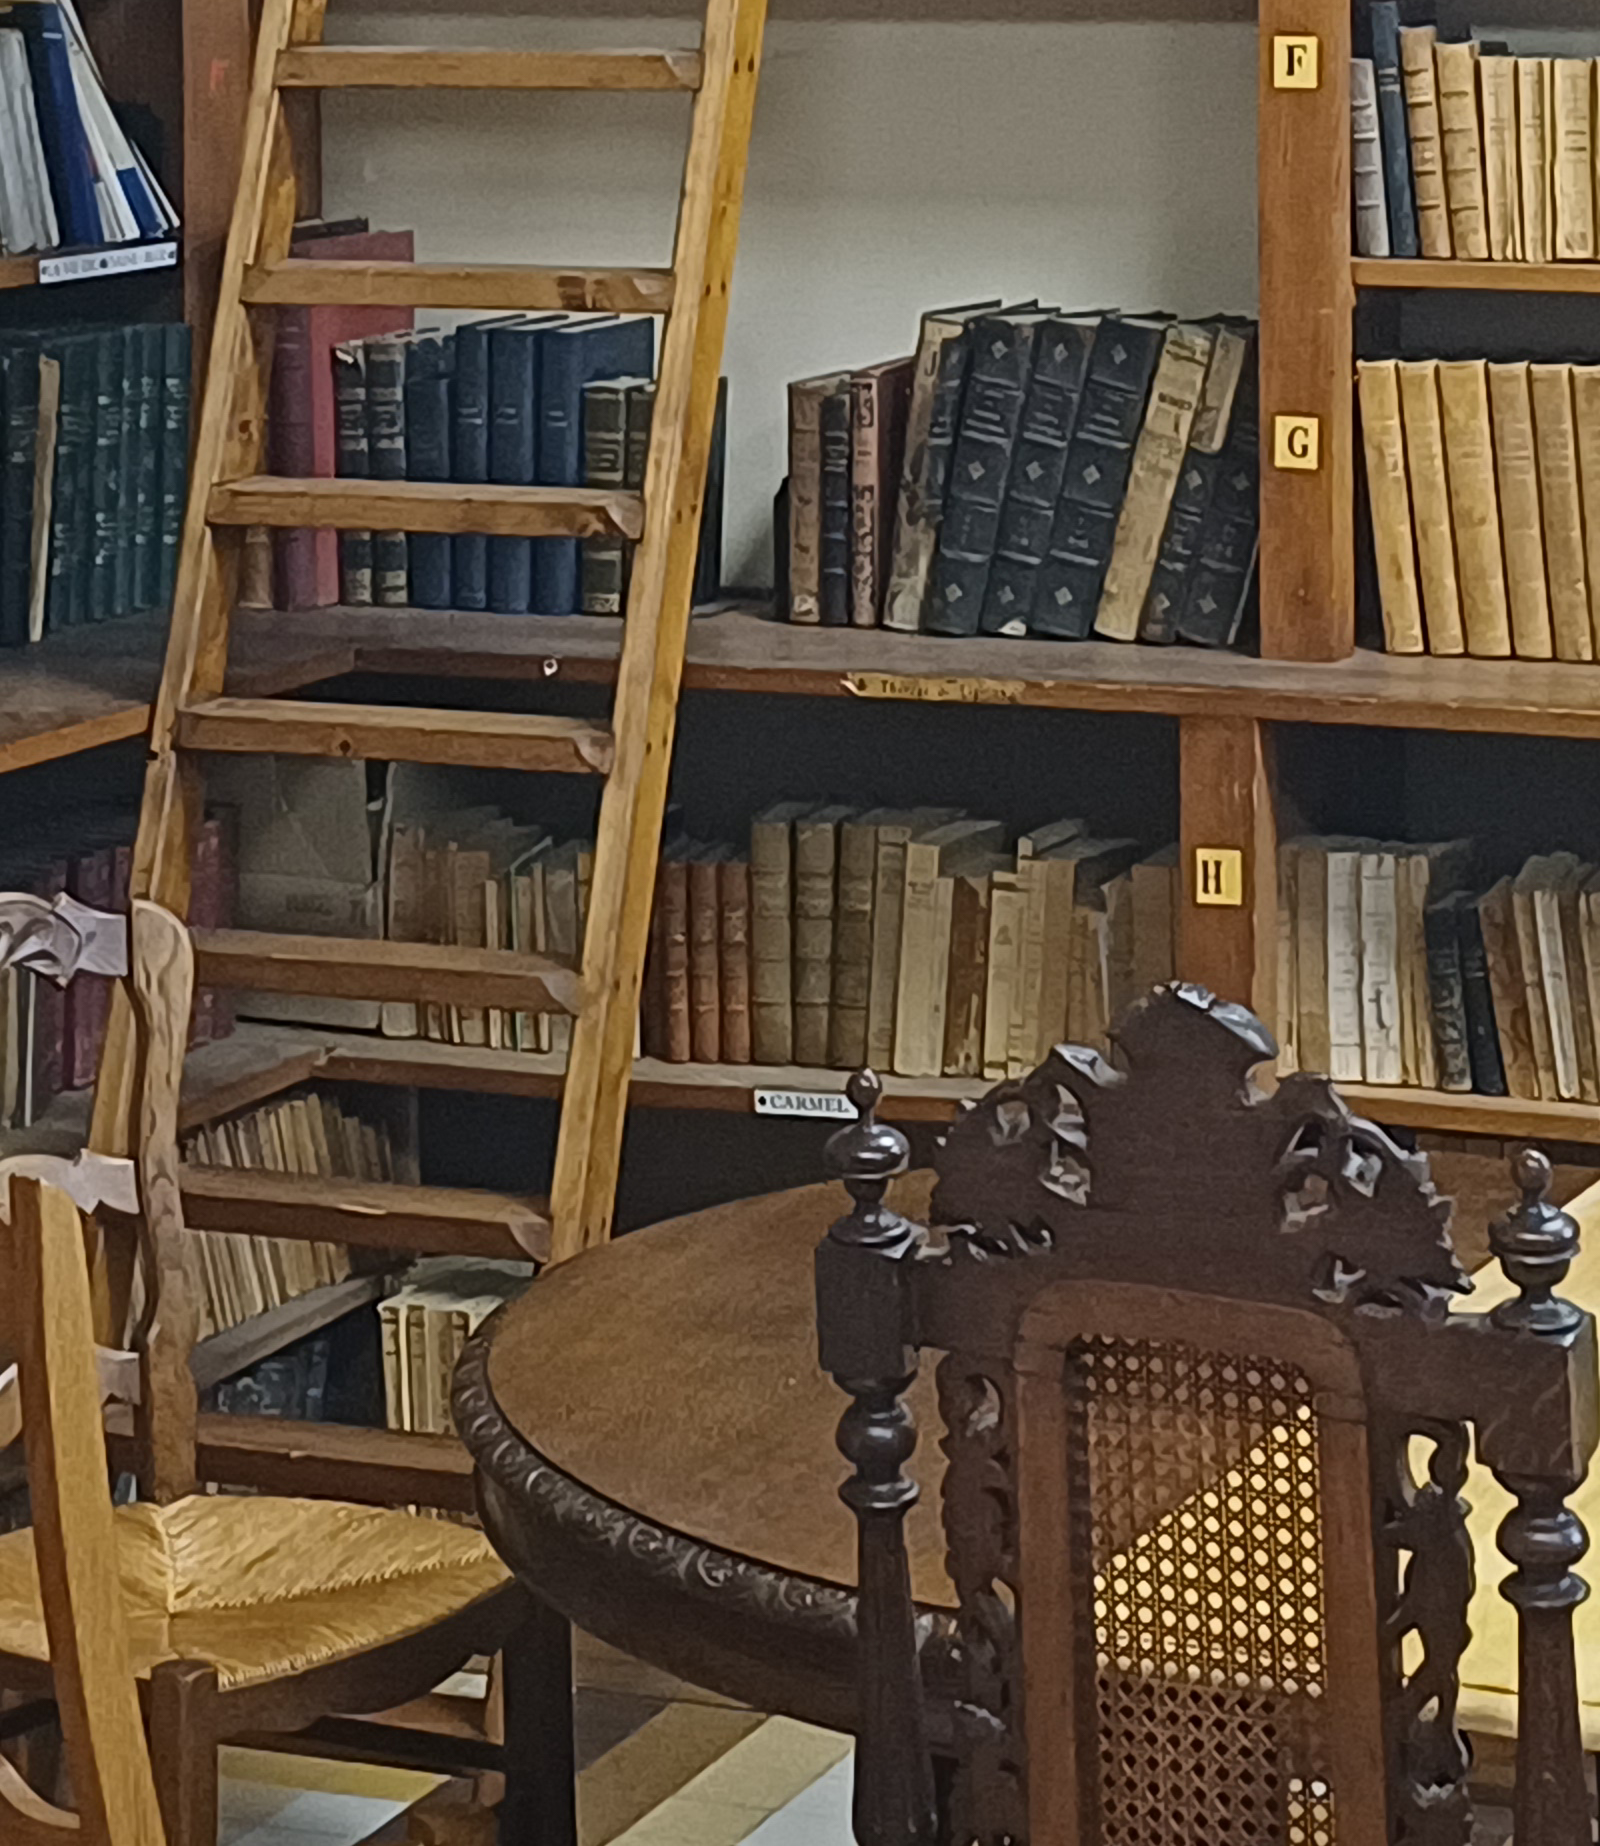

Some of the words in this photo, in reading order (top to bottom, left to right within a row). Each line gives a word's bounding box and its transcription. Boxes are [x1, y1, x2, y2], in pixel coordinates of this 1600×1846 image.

[1287, 45, 1306, 76] F
[1288, 426, 1308, 458] G
[1202, 860, 1221, 894] H
[770, 1094, 850, 1113] CARMEL
